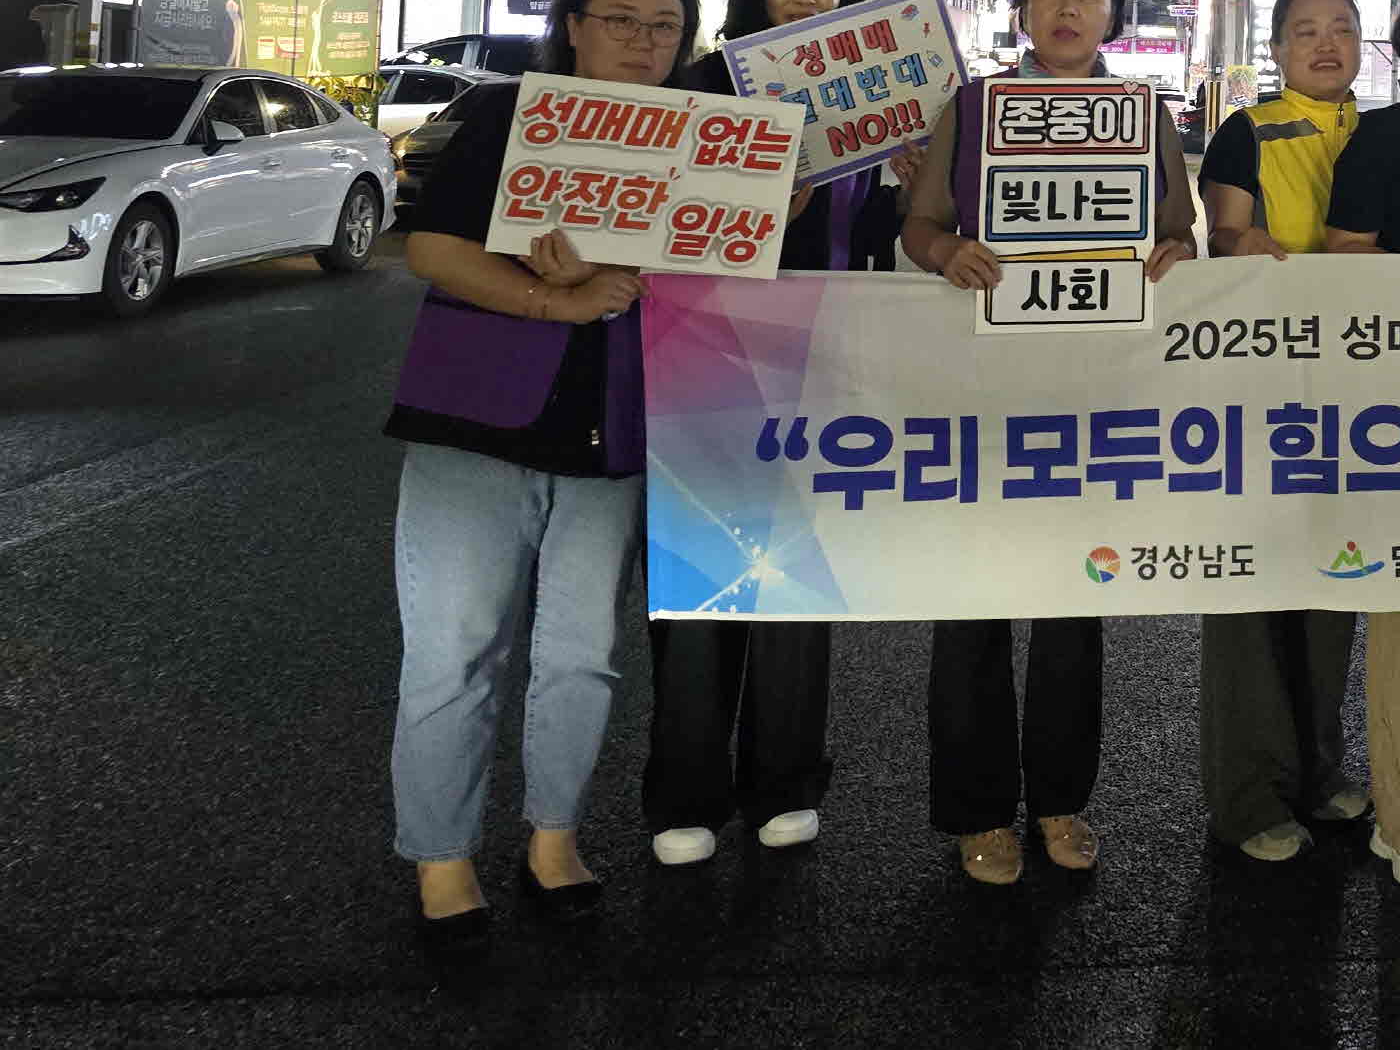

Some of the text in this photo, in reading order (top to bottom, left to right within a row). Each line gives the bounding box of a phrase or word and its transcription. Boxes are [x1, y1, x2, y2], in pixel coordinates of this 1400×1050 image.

[793, 18, 898, 77] 성매매
[521, 92, 793, 172] 성매매 없는
[826, 98, 925, 157] NO!!!
[1001, 96, 1136, 144] 존중이
[505, 165, 776, 263] 안전한 일상
[1001, 180, 1134, 222] 빛나는
[1020, 267, 1110, 311] 사회
[1163, 315, 1321, 361] 2025년
[1002, 404, 1243, 501] 모두의
[1131, 544, 1256, 581] 경상남도
